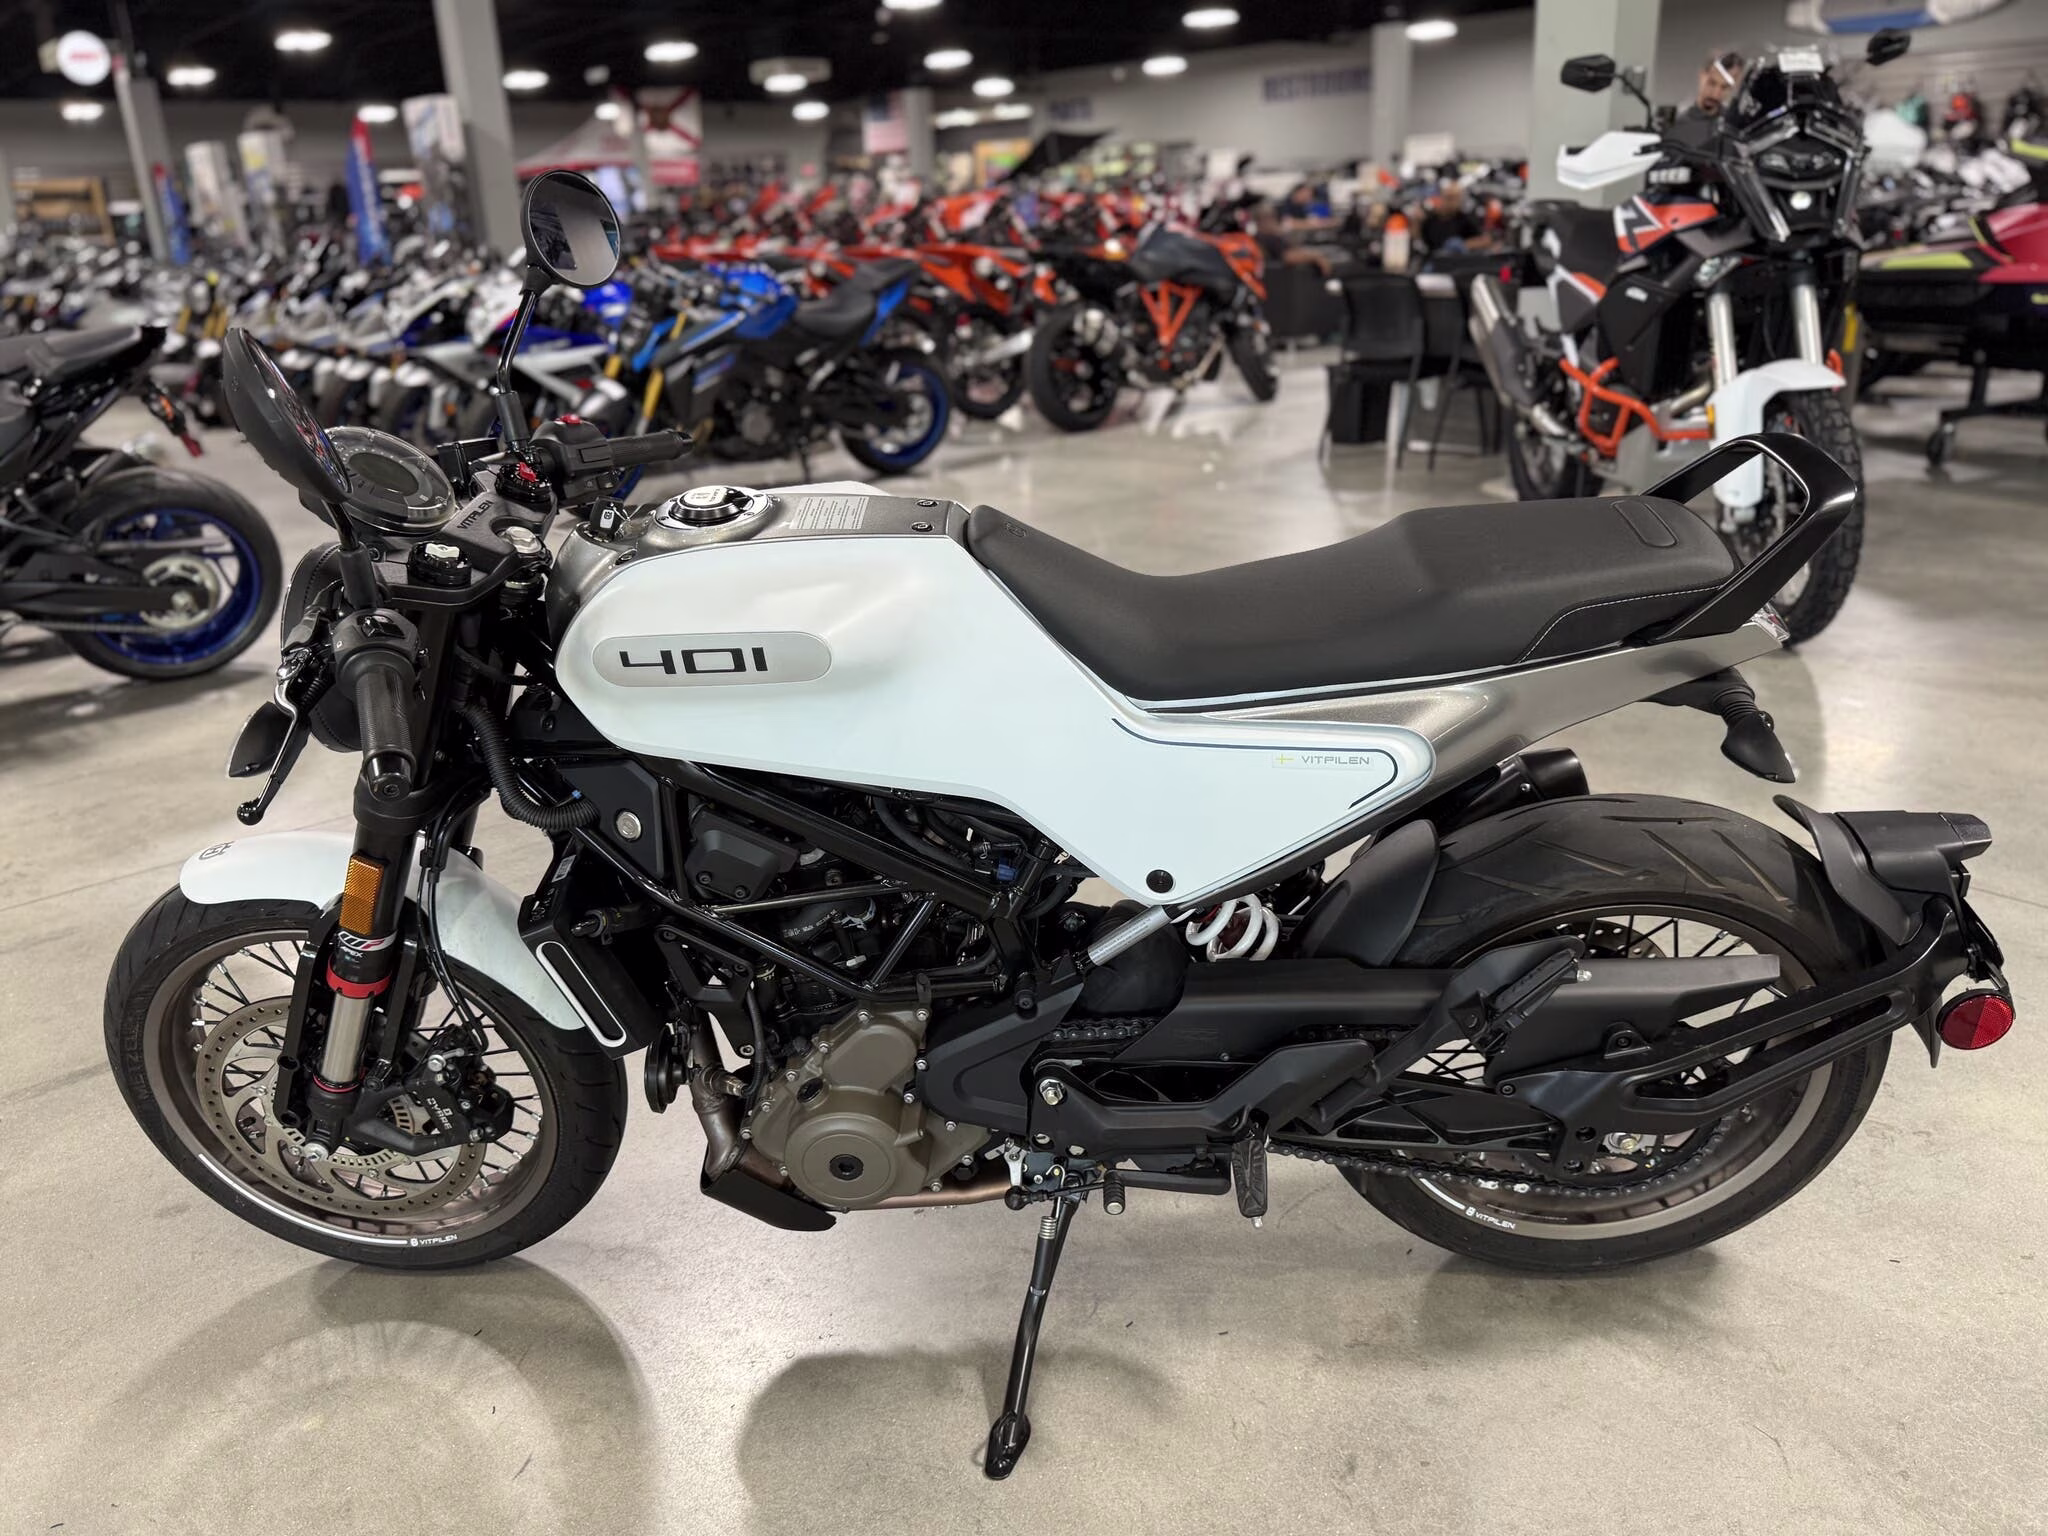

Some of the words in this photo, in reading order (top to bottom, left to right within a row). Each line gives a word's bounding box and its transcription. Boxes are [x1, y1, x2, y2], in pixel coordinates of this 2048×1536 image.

[619, 647, 768, 675] 401
[1301, 755, 1370, 765] VITPILEN
[1475, 1211, 1516, 1229] VITPILEN
[419, 1233, 458, 1245] VITPILEN
